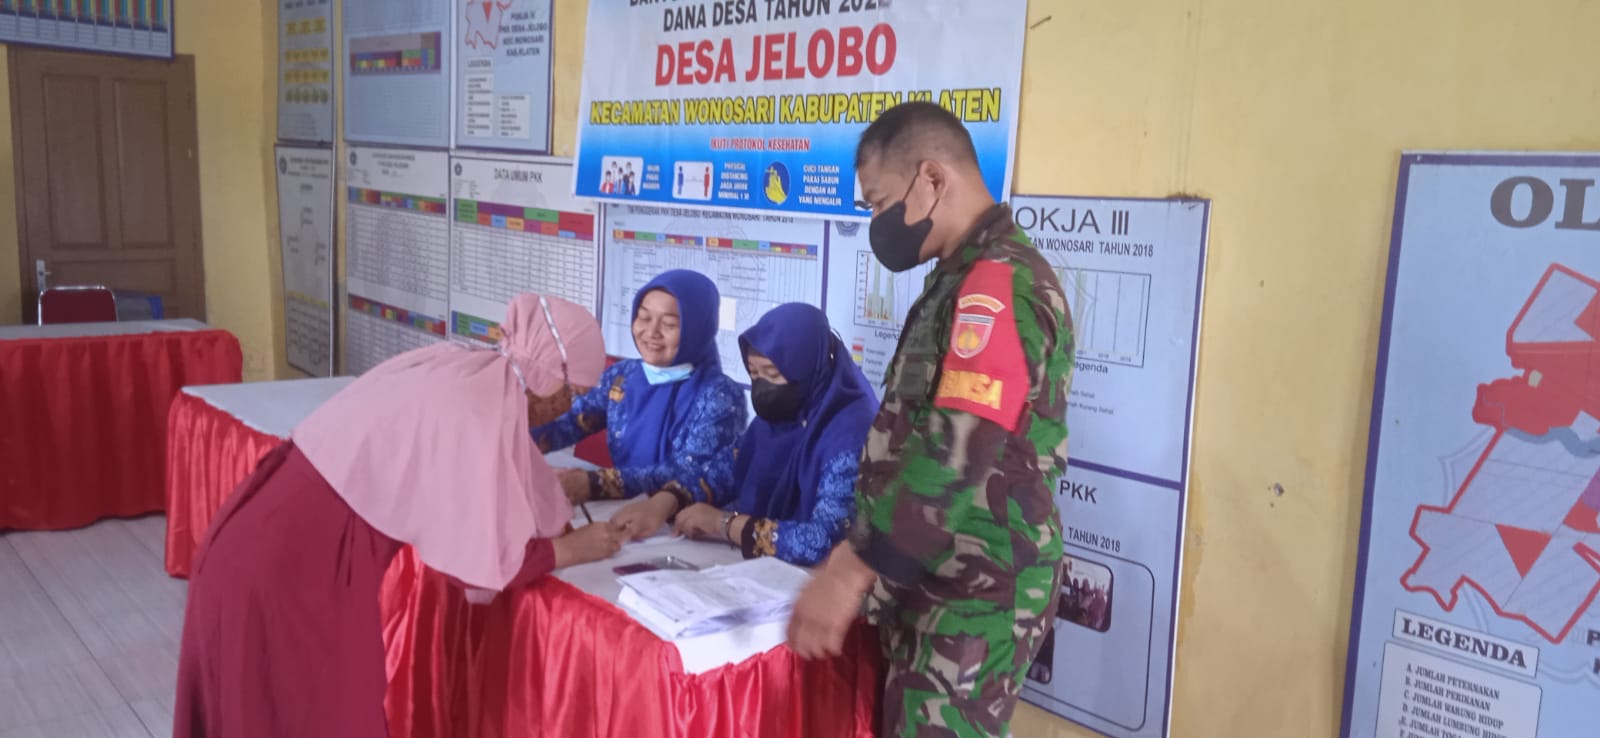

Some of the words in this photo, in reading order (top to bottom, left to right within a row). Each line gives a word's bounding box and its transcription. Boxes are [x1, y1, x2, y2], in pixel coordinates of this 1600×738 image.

[663, 4, 706, 32] DANA
[712, 0, 757, 27] DESA
[765, 0, 830, 21] TAHUN
[655, 38, 736, 86] DESA
[746, 23, 897, 82] JELOBO
[590, 100, 680, 125] KECAMATAN
[684, 95, 775, 125] WONOSARI
[908, 87, 1001, 122] ATEN
[731, 138, 766, 151] PROTOKOL
[767, 138, 810, 152] KESEHATAN
[494, 167, 509, 180] DATA
[530, 170, 543, 184] PKK
[803, 175, 820, 184] PAKAI
[821, 175, 839, 184] SABUN
[818, 164, 840, 173] TANGAN
[799, 195, 814, 204] YANG
[815, 196, 842, 206] MENGALIR
[804, 185, 826, 194] DENGAN
[1111, 209, 1130, 236] III
[1046, 238, 1094, 253] WONOSARI
[1099, 241, 1130, 256] TAHUN
[1132, 244, 1154, 257] 2018
[1060, 479, 1097, 504] PKK
[1068, 526, 1098, 547] TAHUN
[1100, 536, 1121, 553] 2018
[1401, 617, 1527, 669] LEGENDA
[1413, 679, 1445, 697] JUMLAH
[1445, 688, 1491, 712] PERIKANAN
[1415, 666, 1446, 684] JUMLAH
[1447, 675, 1500, 700] PETERNAKAN
[1411, 706, 1441, 724] JUMLAH
[1443, 716, 1480, 737] LUMBUNG
[1412, 692, 1443, 711] JUMLAH
[1444, 703, 1477, 721] WARUNG
[1478, 713, 1504, 730] HIDUP
[1409, 719, 1440, 737] JUMLAH
